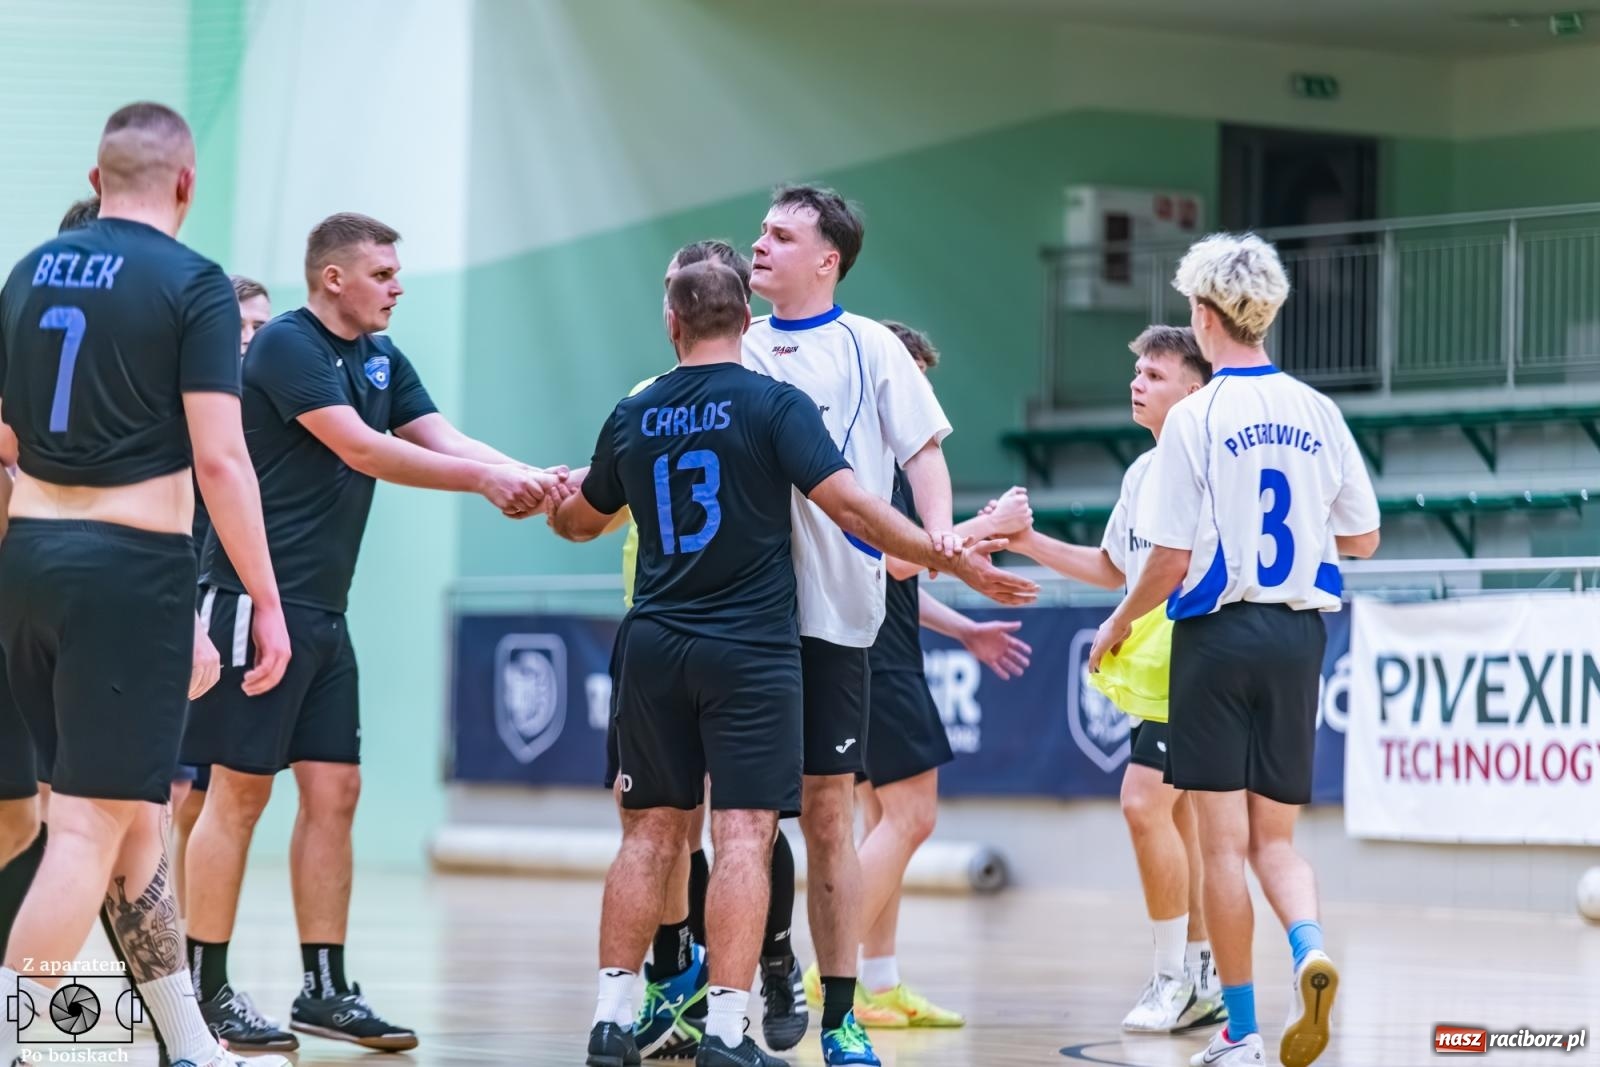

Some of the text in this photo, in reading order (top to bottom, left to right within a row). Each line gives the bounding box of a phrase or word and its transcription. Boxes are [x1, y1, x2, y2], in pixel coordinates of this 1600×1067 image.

[32, 253, 124, 290] BELEK
[39, 305, 87, 432] 7
[641, 401, 732, 437] CARLOS
[653, 449, 722, 555] 13
[1257, 468, 1295, 588] 3
[1380, 738, 1600, 782] TECHNOLOG
